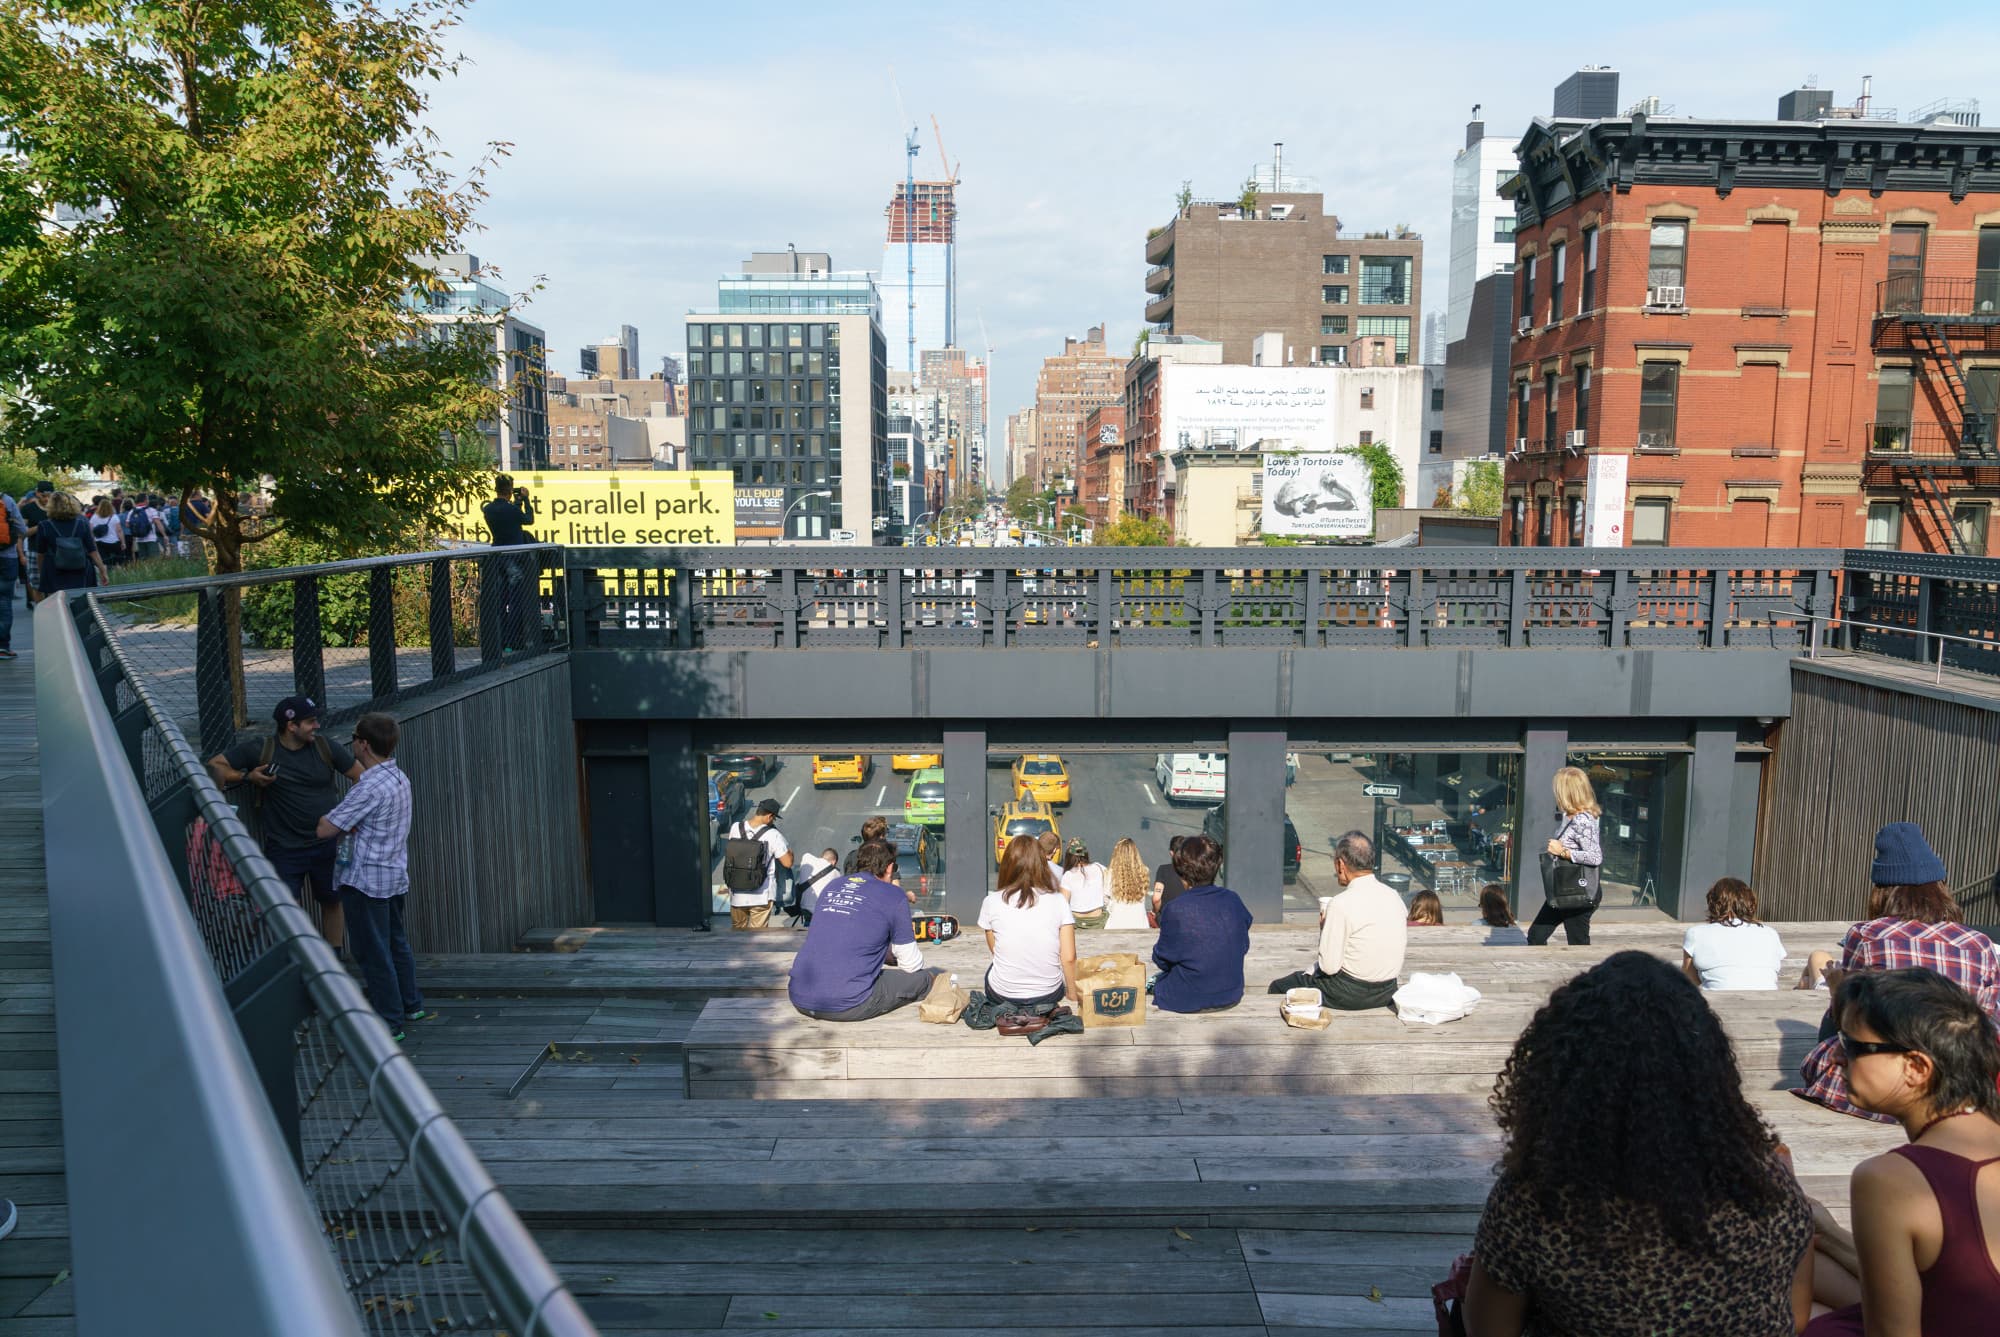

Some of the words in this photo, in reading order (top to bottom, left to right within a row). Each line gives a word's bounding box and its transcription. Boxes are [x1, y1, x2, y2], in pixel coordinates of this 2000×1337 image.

[1266, 458, 1290, 466] Love
[1302, 456, 1344, 466] Tortoise
[1266, 467, 1301, 478] Today!
[754, 489, 771, 497] END
[771, 489, 784, 497] UP
[551, 491, 645, 521] parallel
[655, 491, 720, 521] park.
[569, 521, 626, 544] little
[635, 525, 721, 544] secret.
[1101, 991, 1130, 1009] C&P
